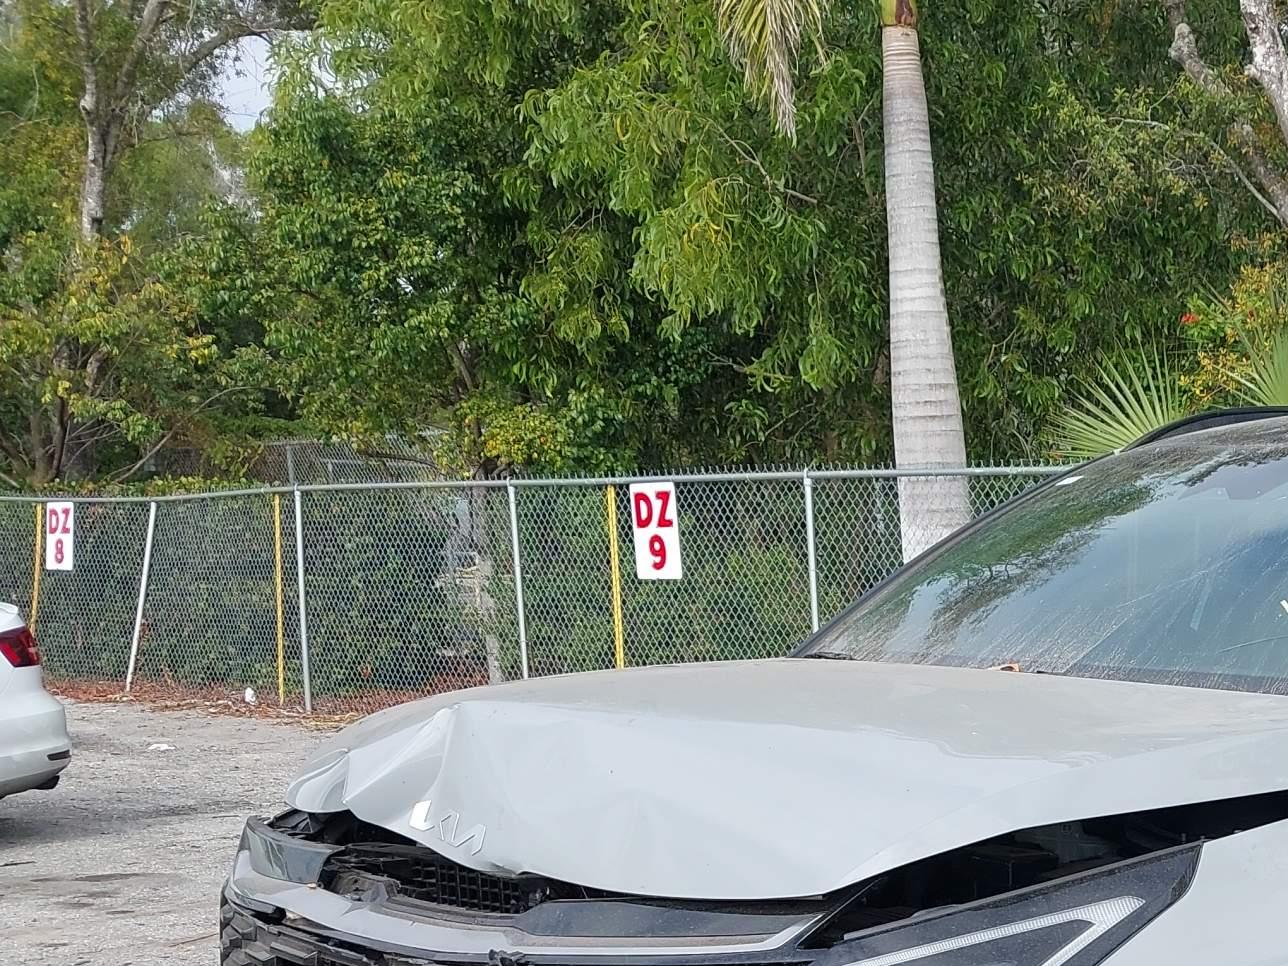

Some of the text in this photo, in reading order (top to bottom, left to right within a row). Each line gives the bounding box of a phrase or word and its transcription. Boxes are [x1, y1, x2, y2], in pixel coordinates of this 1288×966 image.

[48, 508, 71, 534] DZ
[633, 490, 673, 529] DZ
[54, 537, 65, 564] 8
[649, 534, 667, 570] 9
[408, 800, 486, 857] KIA
